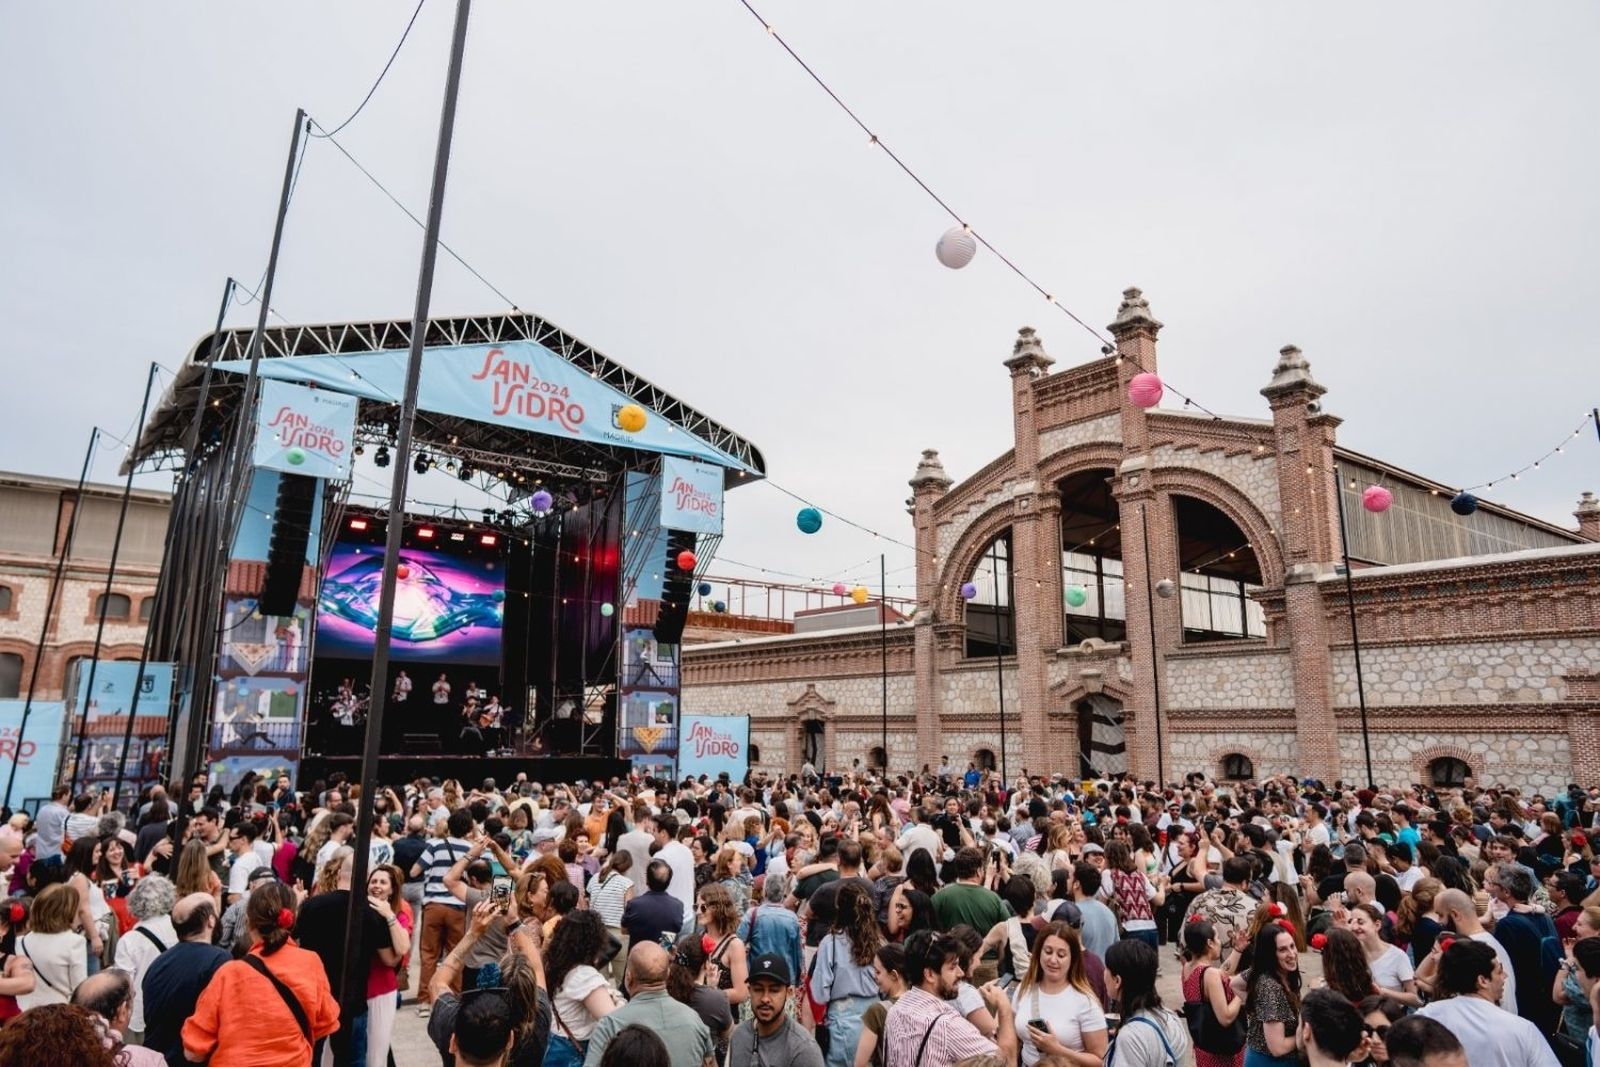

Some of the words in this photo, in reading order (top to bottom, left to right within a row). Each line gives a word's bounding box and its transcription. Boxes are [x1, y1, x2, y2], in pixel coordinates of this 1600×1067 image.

[472, 349, 530, 385] SAN
[531, 377, 569, 399] 2024
[493, 380, 585, 434] ISIDRO
[268, 406, 308, 428] SAN
[308, 423, 335, 437] 2024
[281, 426, 345, 458] ISIDRO
[668, 476, 693, 495] SAN
[676, 493, 717, 517] ISIDRO
[686, 721, 712, 742] SAN
[696, 738, 739, 759] ISIDRO
